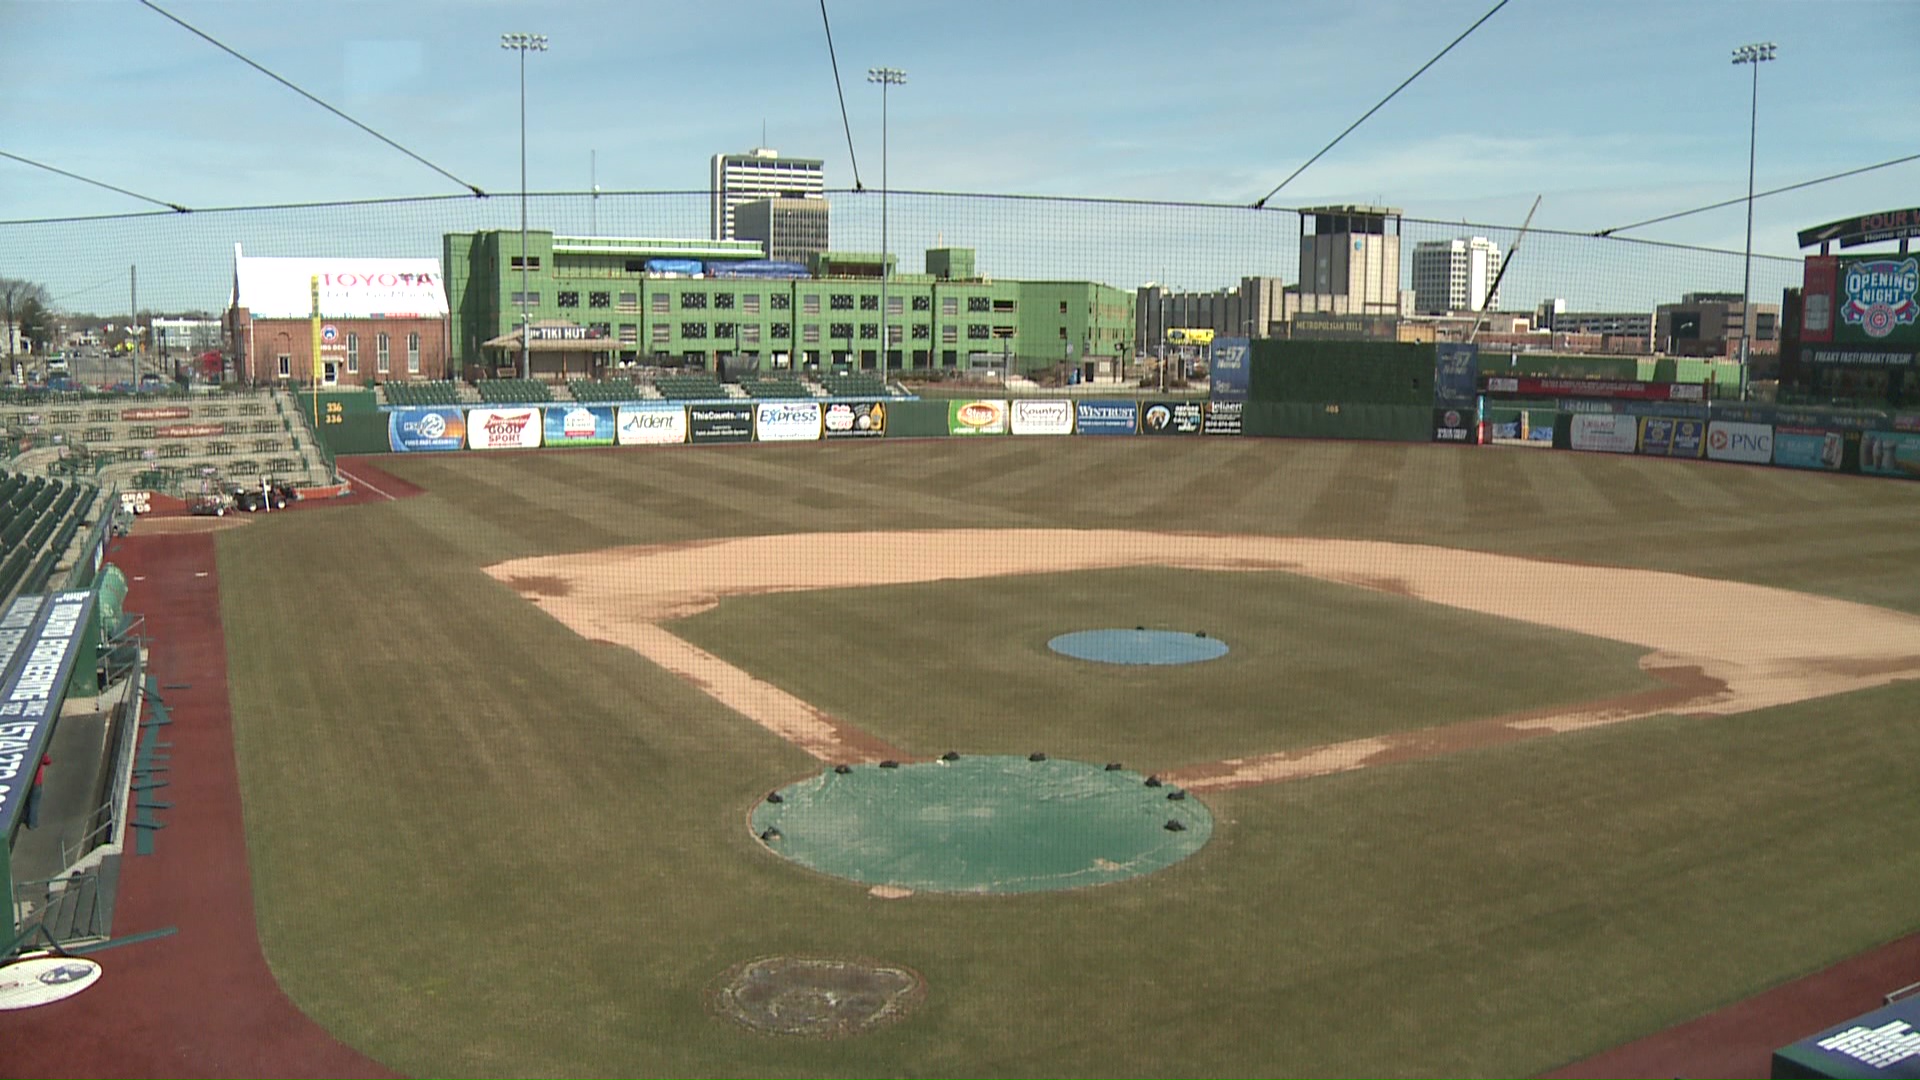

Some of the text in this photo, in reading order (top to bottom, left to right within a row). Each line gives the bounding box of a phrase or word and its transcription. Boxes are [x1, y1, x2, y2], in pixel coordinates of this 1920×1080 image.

[1861, 210, 1906, 230] FOUR
[1864, 232, 1894, 243] Home
[1897, 228, 1907, 238] of
[322, 273, 434, 287] TOYOTA
[1849, 273, 1915, 293] OPENING
[1862, 289, 1900, 303] NIGHT
[542, 328, 562, 340] TIKI
[564, 328, 587, 340] HUT
[1227, 347, 1246, 361] 57
[327, 403, 342, 412] 336
[1020, 403, 1066, 421] Kountry
[1078, 406, 1135, 417] WINTRUST
[326, 415, 342, 423] 336
[760, 409, 817, 425] Express
[488, 425, 521, 435] GOOD
[489, 433, 520, 442] SPORT
[1731, 434, 1770, 452] PNC
